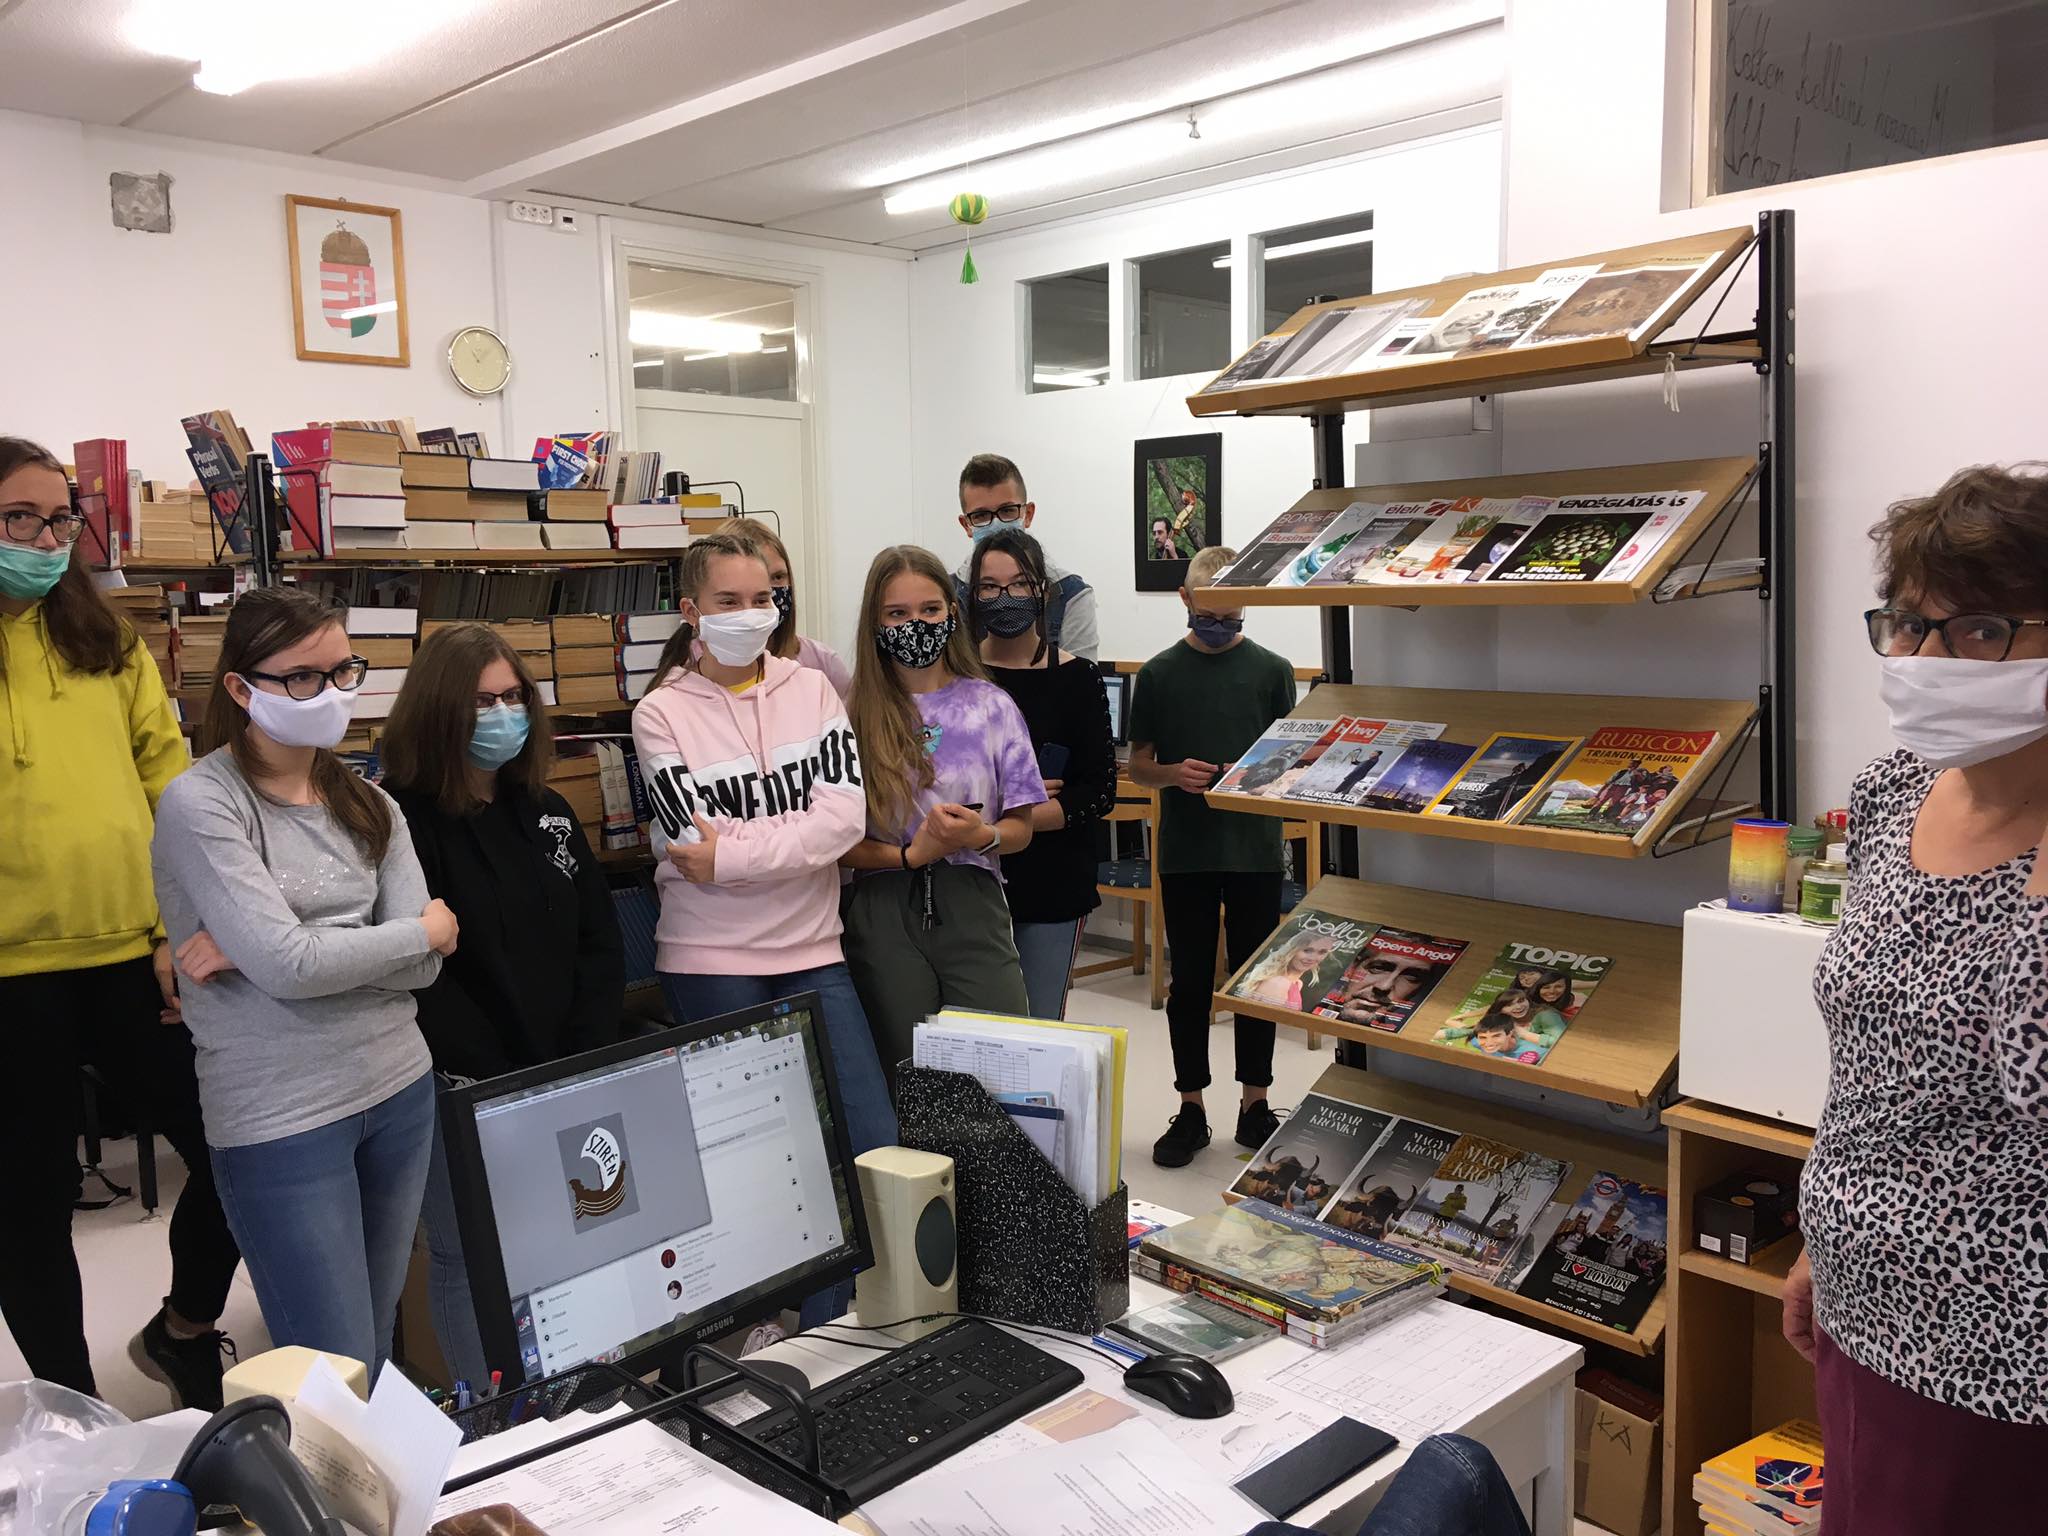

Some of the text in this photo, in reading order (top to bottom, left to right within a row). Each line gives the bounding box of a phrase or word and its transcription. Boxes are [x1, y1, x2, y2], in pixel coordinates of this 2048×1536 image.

[193, 447, 218, 465] Phrasal
[198, 465, 221, 479] Verbs
[212, 488, 240, 517] 100
[1557, 495, 1667, 510] VENDÉGLÁTÁS
[1350, 724, 1379, 739] hvg
[1593, 732, 1707, 752] RUBICON
[1586, 749, 1690, 764] TRIANON-TRAUMA
[631, 760, 644, 810] LONGMAN
[1301, 913, 1367, 941] bella
[1332, 936, 1369, 953] girl
[1370, 937, 1456, 961] 5perc Angol
[1510, 942, 1609, 973] TOPIC
[1319, 1105, 1364, 1126] MAGYAR
[585, 1133, 618, 1176] SZIRÉN
[1461, 1146, 1535, 1179] MAGYAR
[1385, 1246, 1412, 1260] RAJZ
[1561, 1261, 1571, 1272] I
[1583, 1268, 1632, 1292] LONDON
[695, 1314, 736, 1340] SAMSUNG
